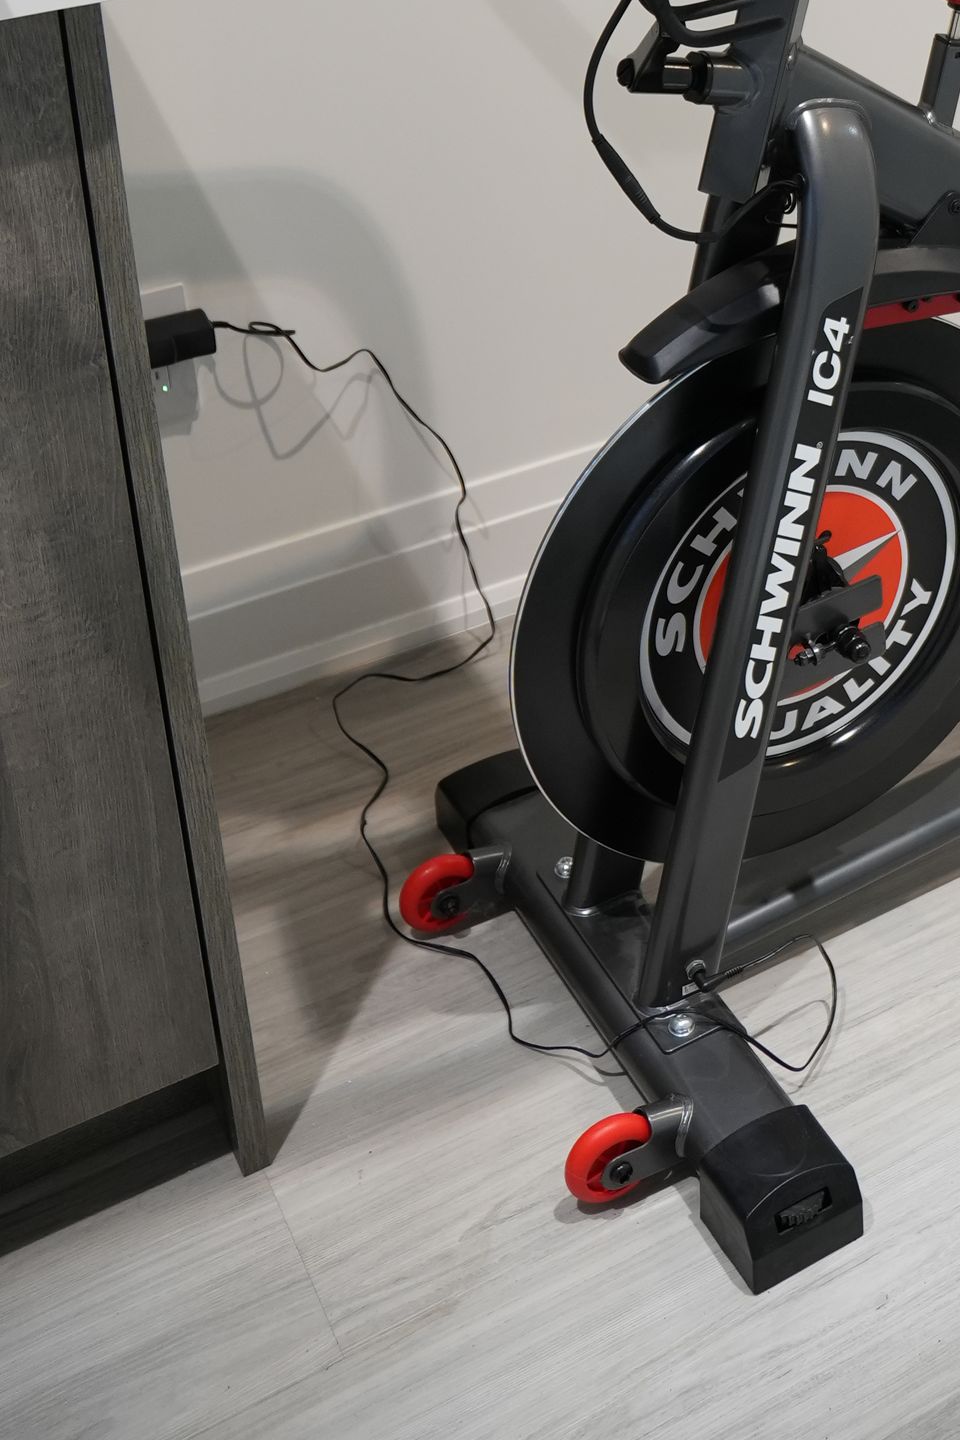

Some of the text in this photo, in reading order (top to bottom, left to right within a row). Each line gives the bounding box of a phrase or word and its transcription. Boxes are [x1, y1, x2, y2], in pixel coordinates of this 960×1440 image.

[655, 448, 918, 657] SCHNN
[734, 316, 850, 740] SCHWINN IC4
[769, 577, 932, 740] UALITY
